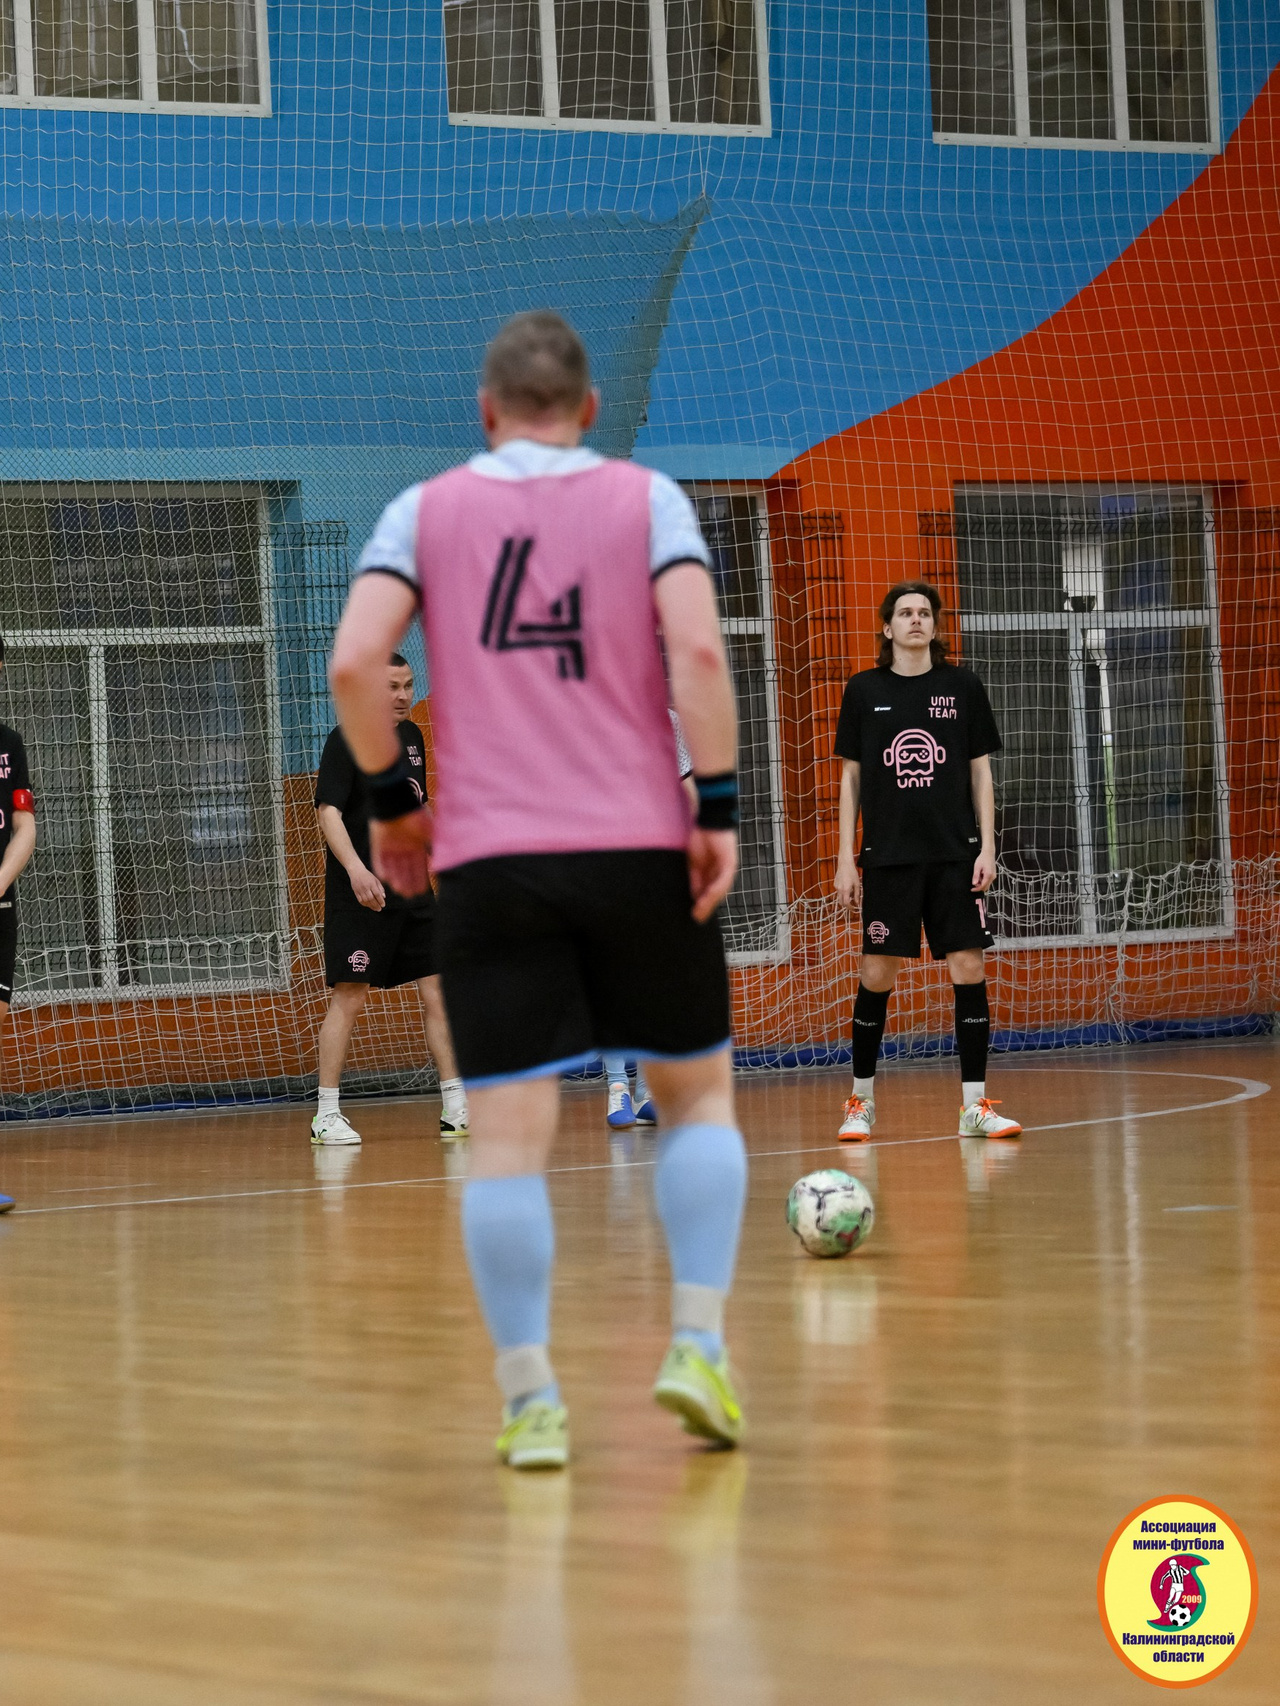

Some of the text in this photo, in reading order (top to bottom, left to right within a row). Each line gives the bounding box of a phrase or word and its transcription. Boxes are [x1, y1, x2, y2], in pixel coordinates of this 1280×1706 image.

[481, 537, 585, 680] 4
[930, 696, 956, 707] UNIT
[928, 707, 957, 720] TEAM
[897, 776, 934, 789] UNIT
